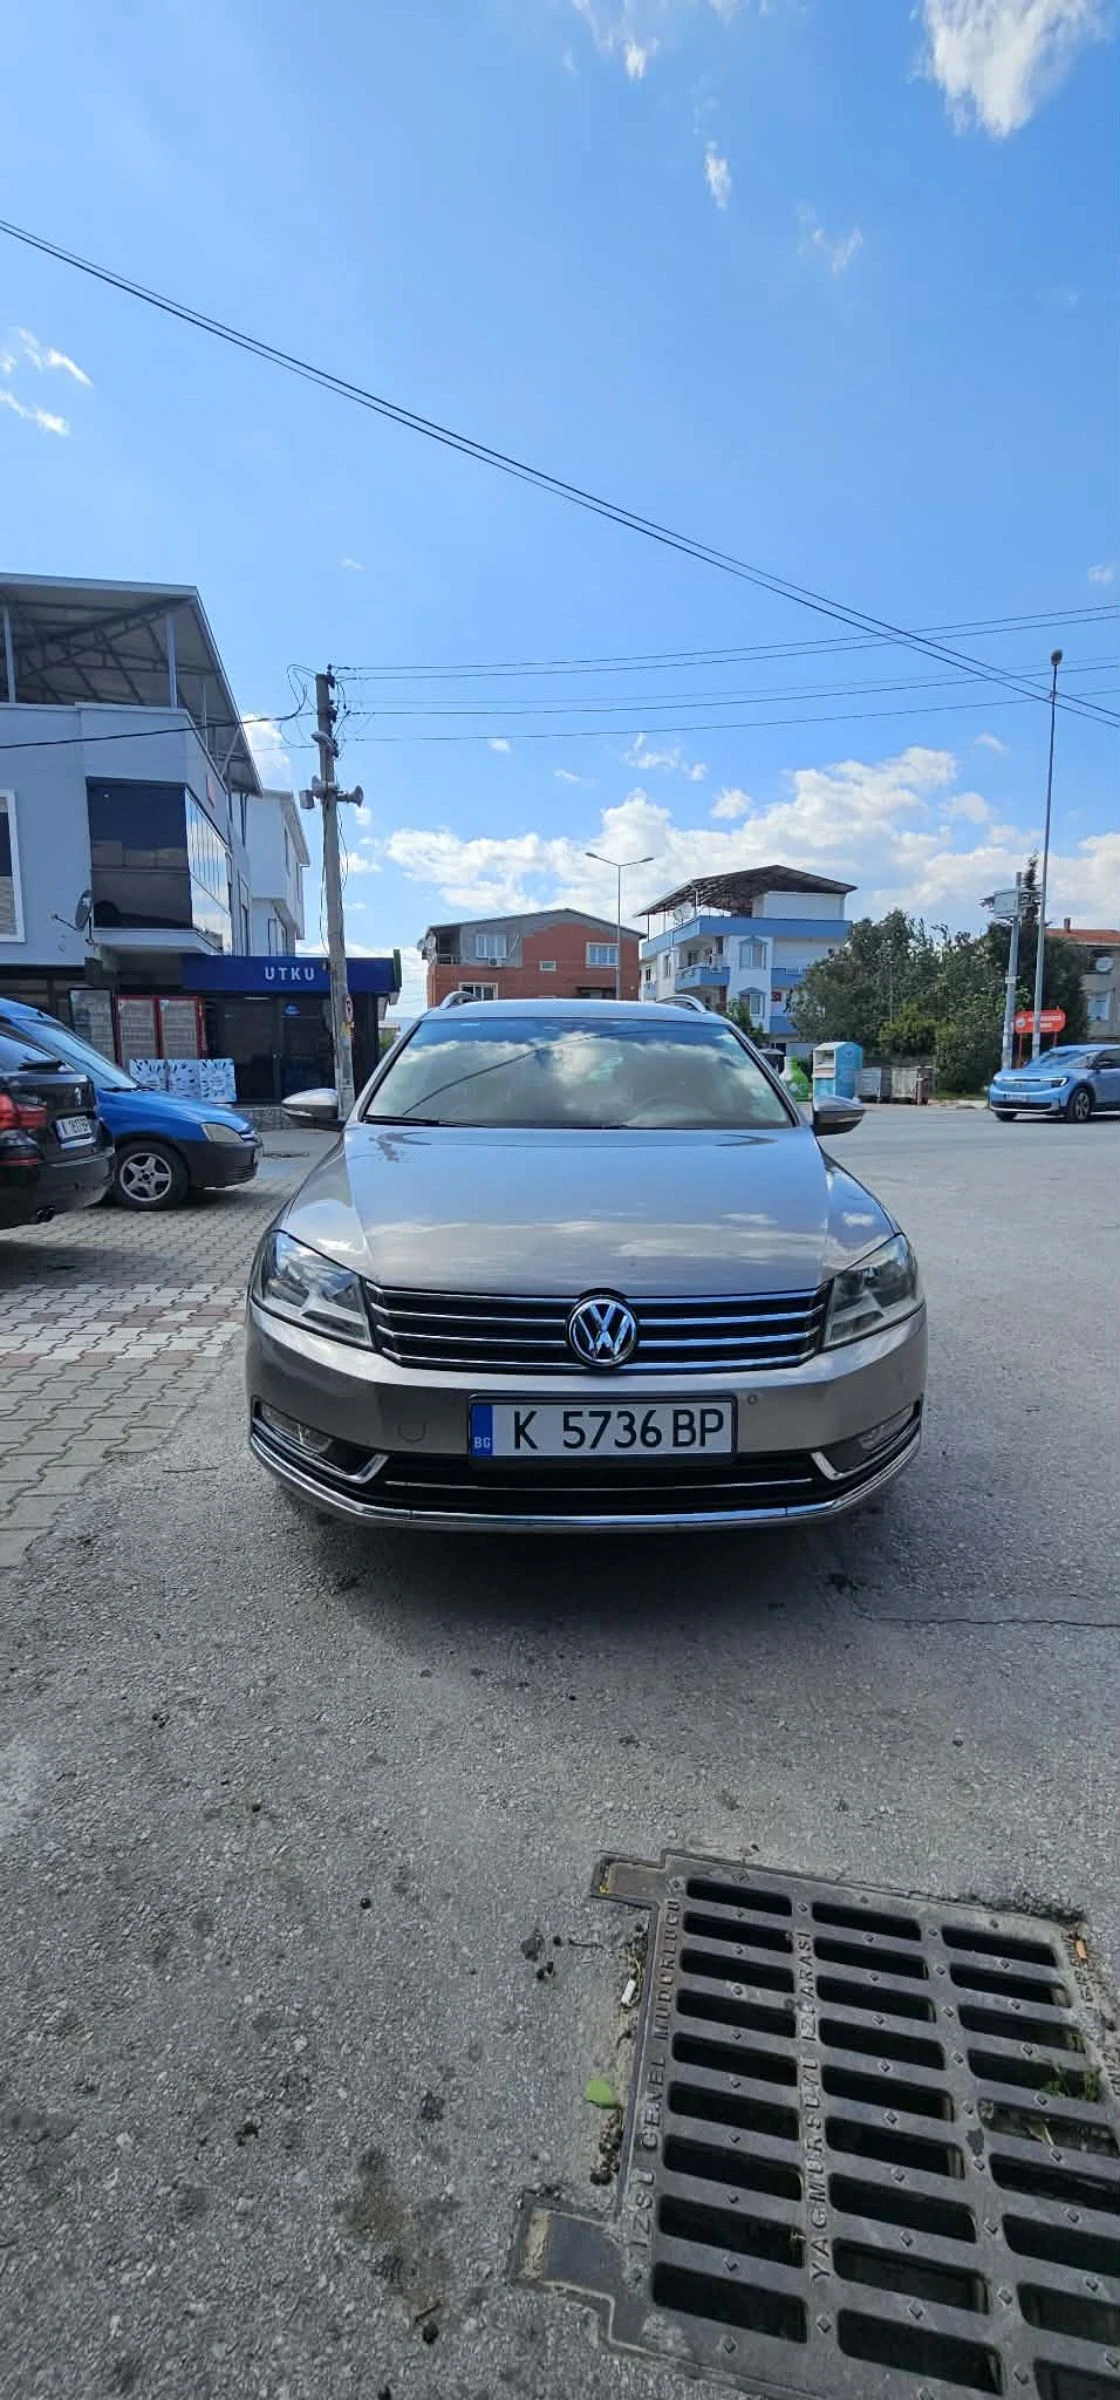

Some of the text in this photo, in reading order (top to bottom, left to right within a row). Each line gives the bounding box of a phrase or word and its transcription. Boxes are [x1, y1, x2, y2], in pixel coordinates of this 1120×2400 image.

[264, 966, 315, 981] UTKU
[513, 1408, 725, 1450] K 5736 BP
[473, 1436, 491, 1449] BG
